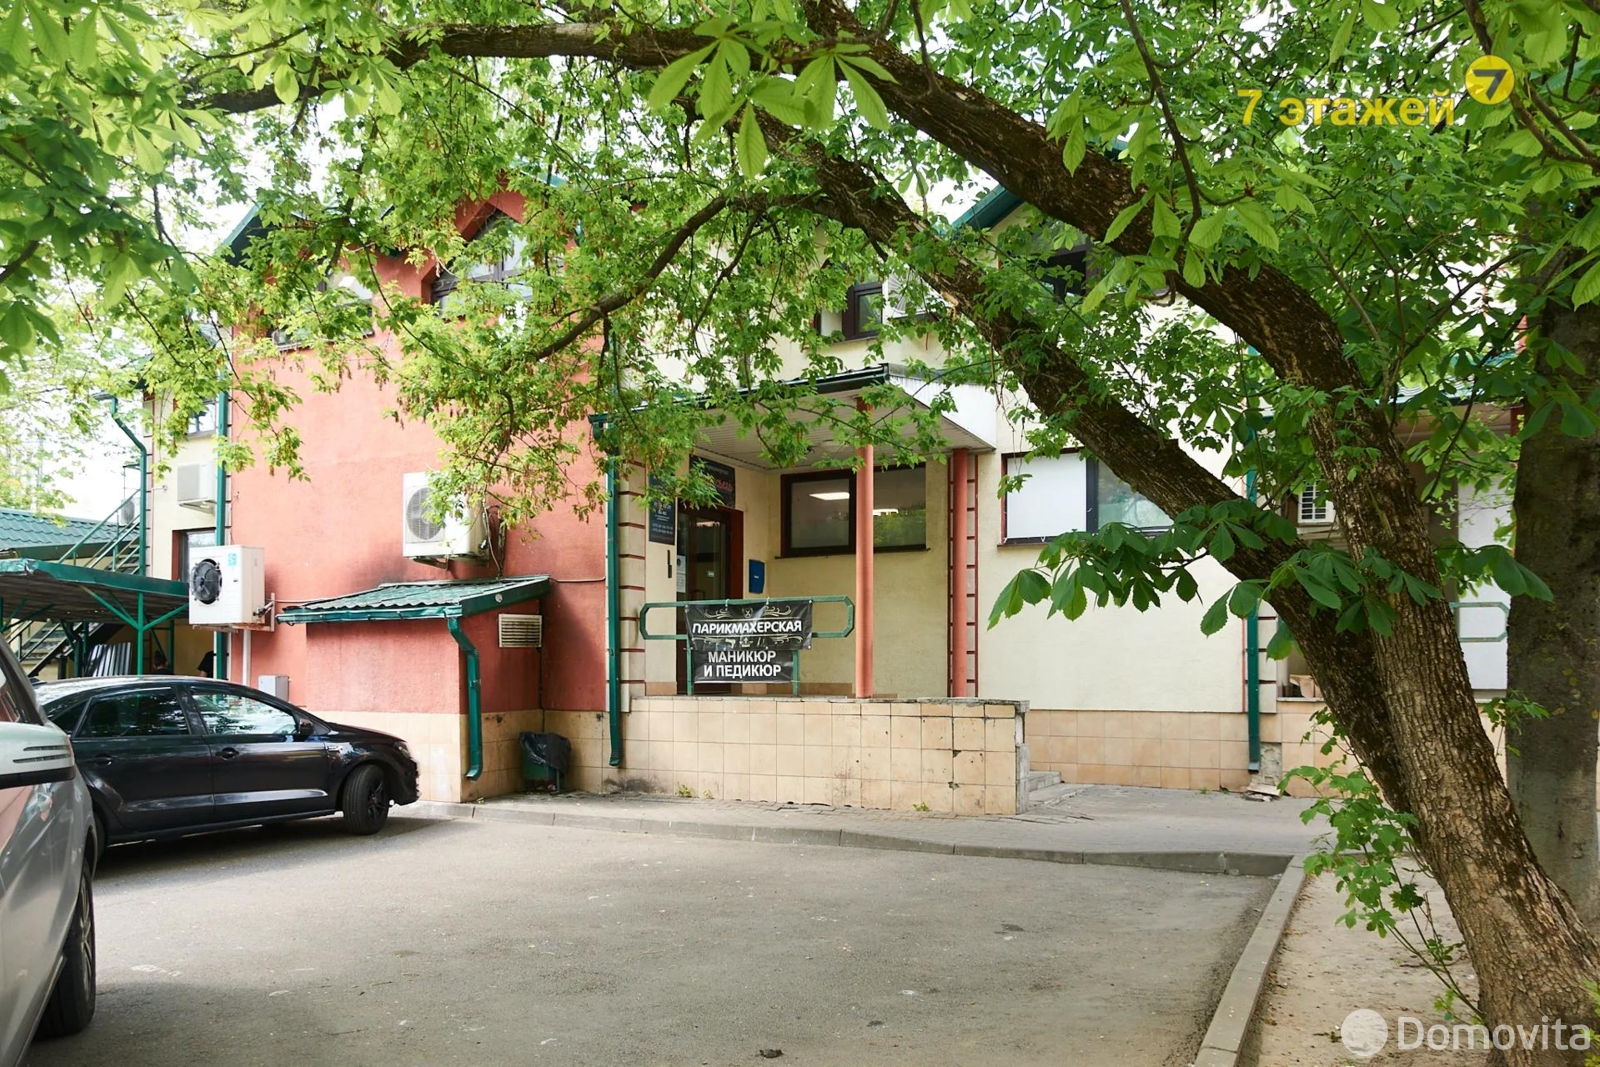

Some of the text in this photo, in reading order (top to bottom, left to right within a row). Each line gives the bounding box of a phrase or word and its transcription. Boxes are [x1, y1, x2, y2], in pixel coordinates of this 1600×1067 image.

[692, 620, 803, 634] ПАРИКМАХЕРСКАЯ
[708, 650, 777, 663] МАНИКЮР
[703, 664, 782, 679] И ПЕДИКЮР
